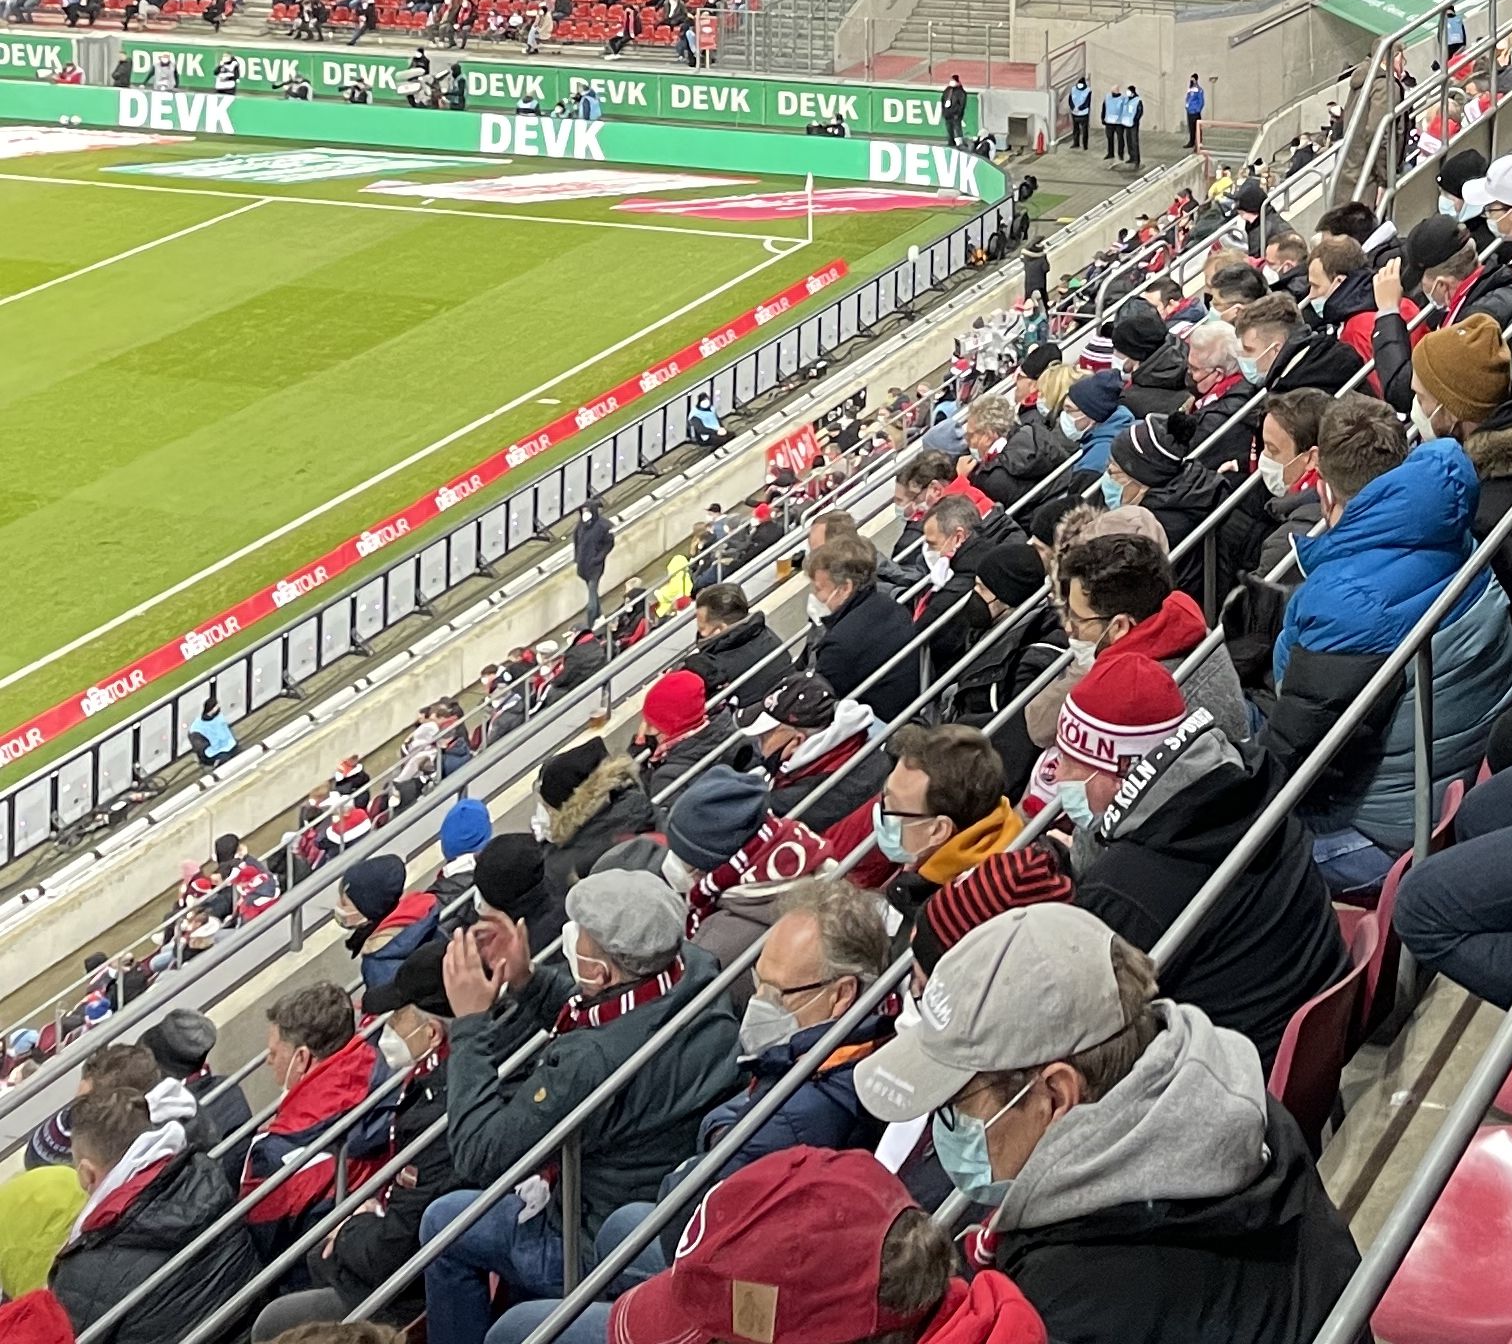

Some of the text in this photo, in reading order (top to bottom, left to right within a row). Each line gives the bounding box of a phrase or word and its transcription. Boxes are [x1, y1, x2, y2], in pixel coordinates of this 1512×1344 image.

[323, 61, 398, 91] DEVK
[468, 71, 545, 100] DEVK
[118, 89, 236, 135] DEVK
[671, 84, 751, 113] DEVK
[777, 91, 860, 121] DEVK
[883, 98, 967, 128] DEV
[480, 112, 606, 161] DEVK
[869, 140, 980, 197] DEVK
[179, 615, 241, 661] DERTOUR
[80, 668, 147, 718] DERTOUR
[0, 727, 45, 764] TOUR
[1114, 759, 1158, 810] KÖLN
